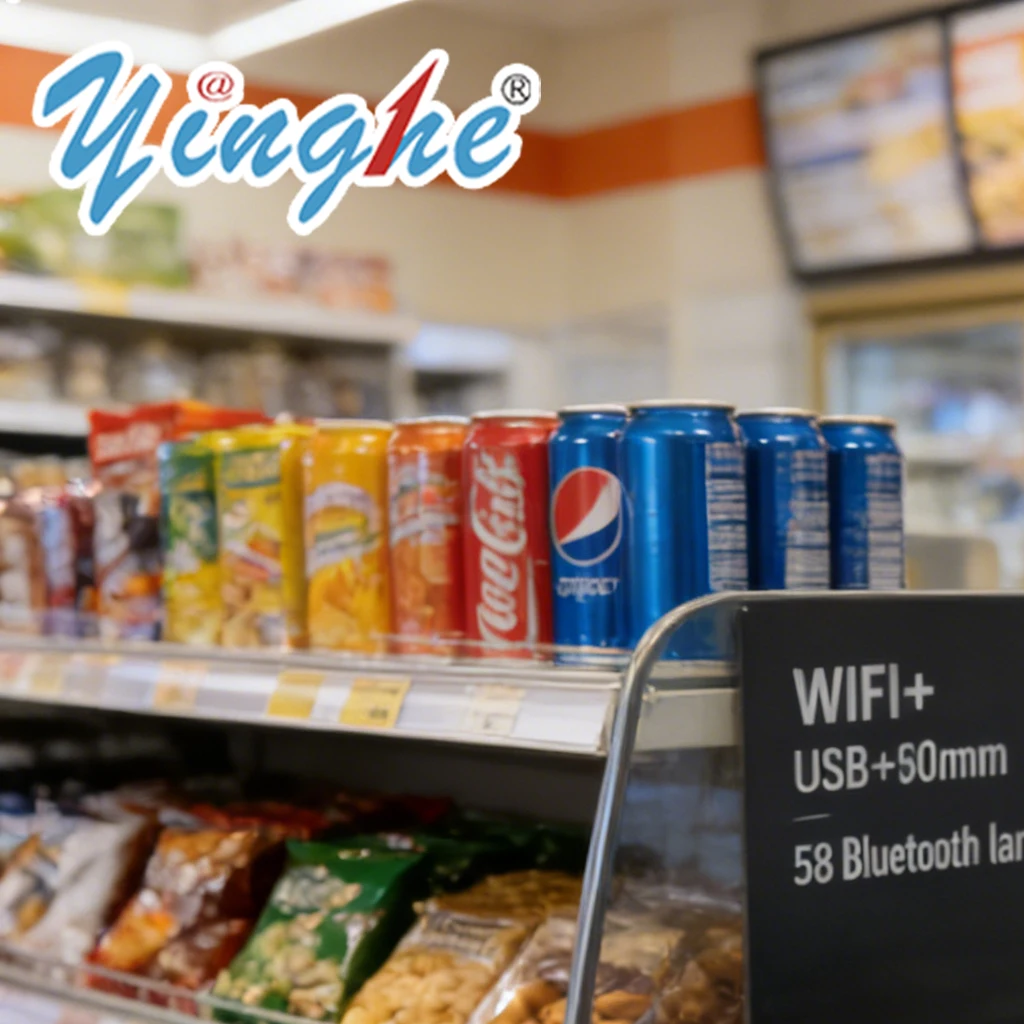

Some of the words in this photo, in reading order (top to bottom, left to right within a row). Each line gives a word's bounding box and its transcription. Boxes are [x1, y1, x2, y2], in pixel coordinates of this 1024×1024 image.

[792, 662, 935, 726] WIFI+
[793, 841, 834, 885] 58
[842, 825, 980, 881] Bluetooth
